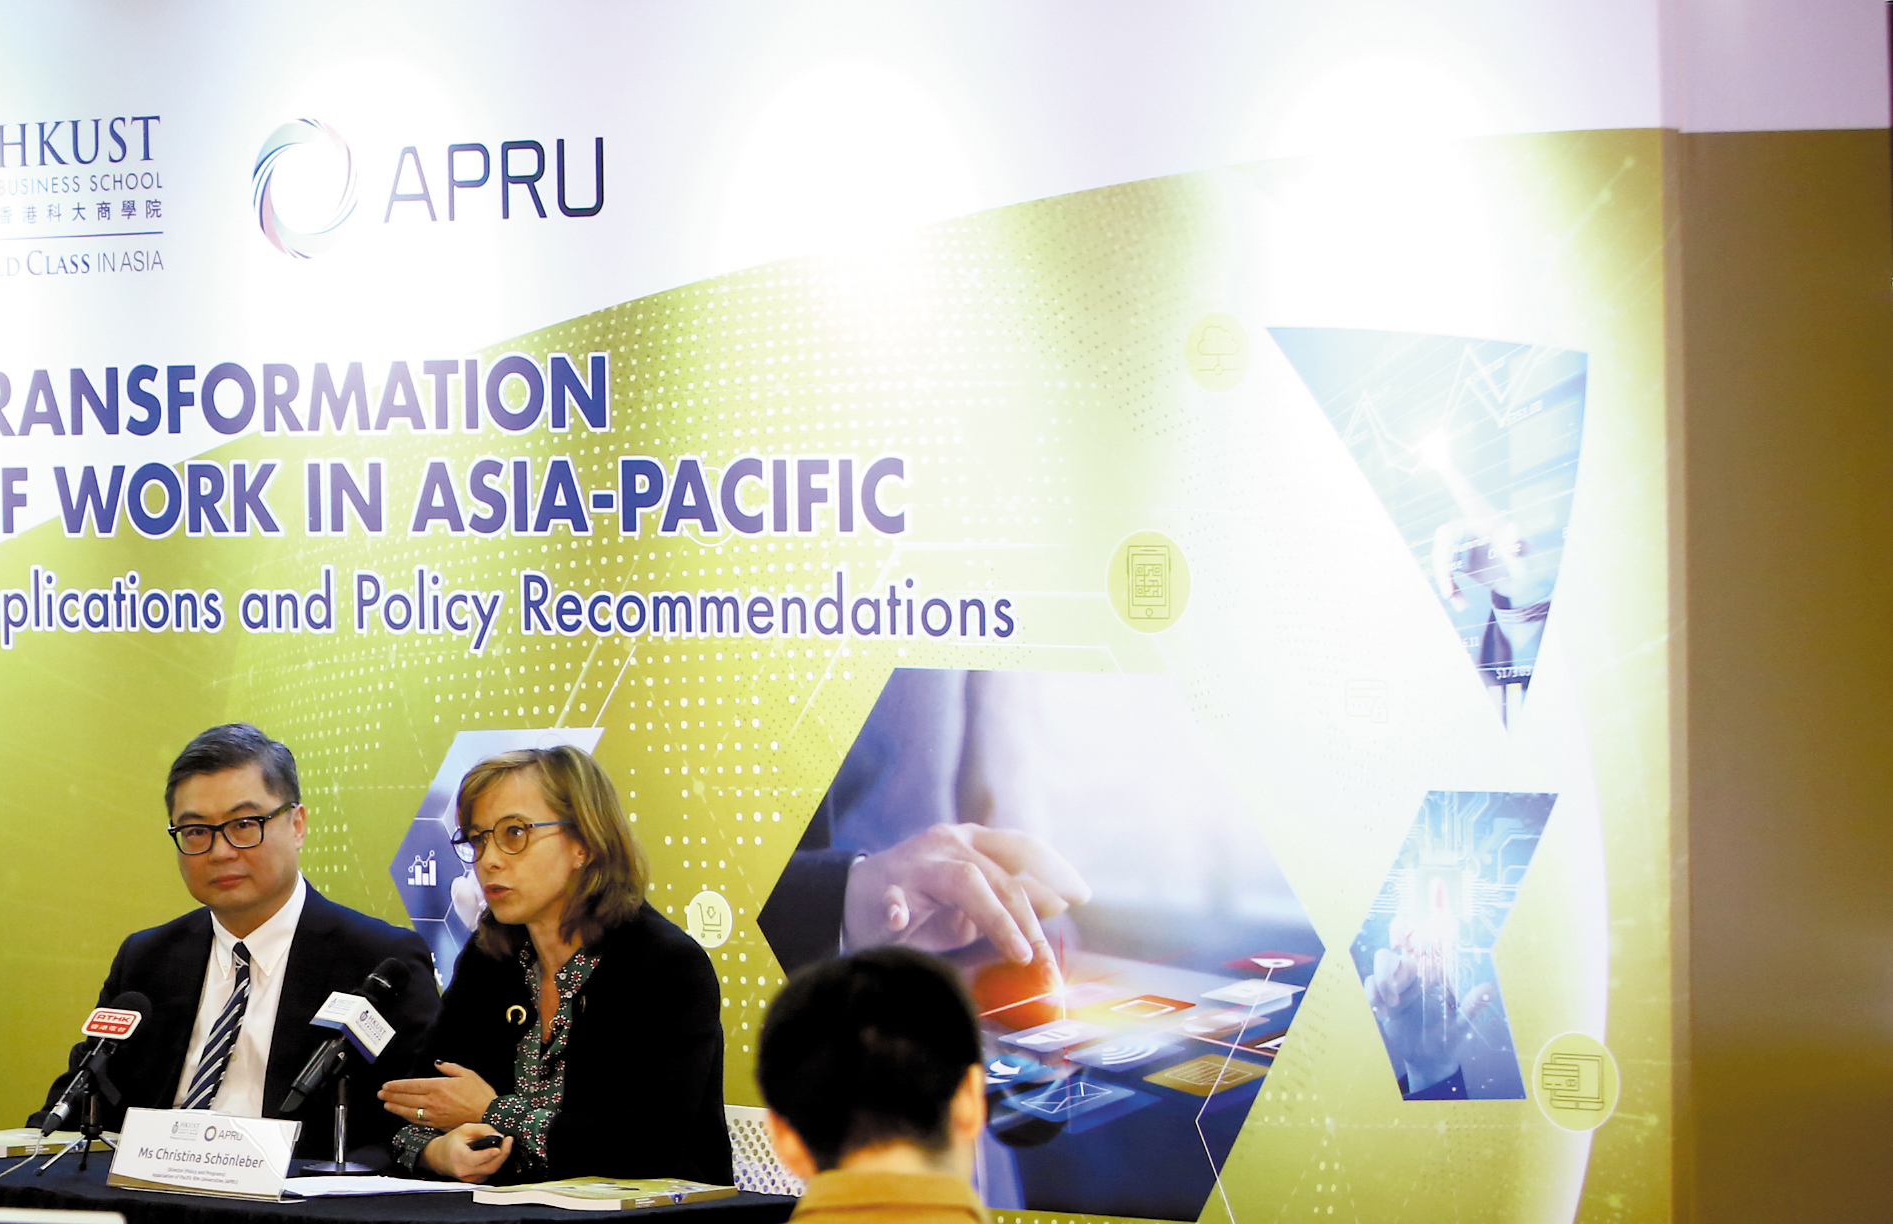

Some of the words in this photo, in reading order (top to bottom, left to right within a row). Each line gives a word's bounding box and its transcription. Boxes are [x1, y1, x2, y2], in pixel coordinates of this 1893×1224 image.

[89, 172, 163, 192] SCHOOL
[384, 137, 604, 223] APRU
[0, 199, 163, 224] 香港科大商學院
[97, 252, 115, 273] IN
[120, 250, 164, 272] ASIA
[54, 462, 280, 535] WORK
[307, 462, 382, 534] IN
[411, 457, 905, 534] ASIA-PACIFIC
[239, 570, 333, 631] and
[355, 571, 503, 652] Policy
[523, 571, 1014, 637] Recommendations
[96, 1014, 131, 1023] RTHK
[368, 1015, 387, 1036] HKUST
[218, 1130, 244, 1141] APRU
[138, 1147, 154, 1159] Ms
[155, 1148, 202, 1163] Christina
[204, 1152, 264, 1169] Schönleber
